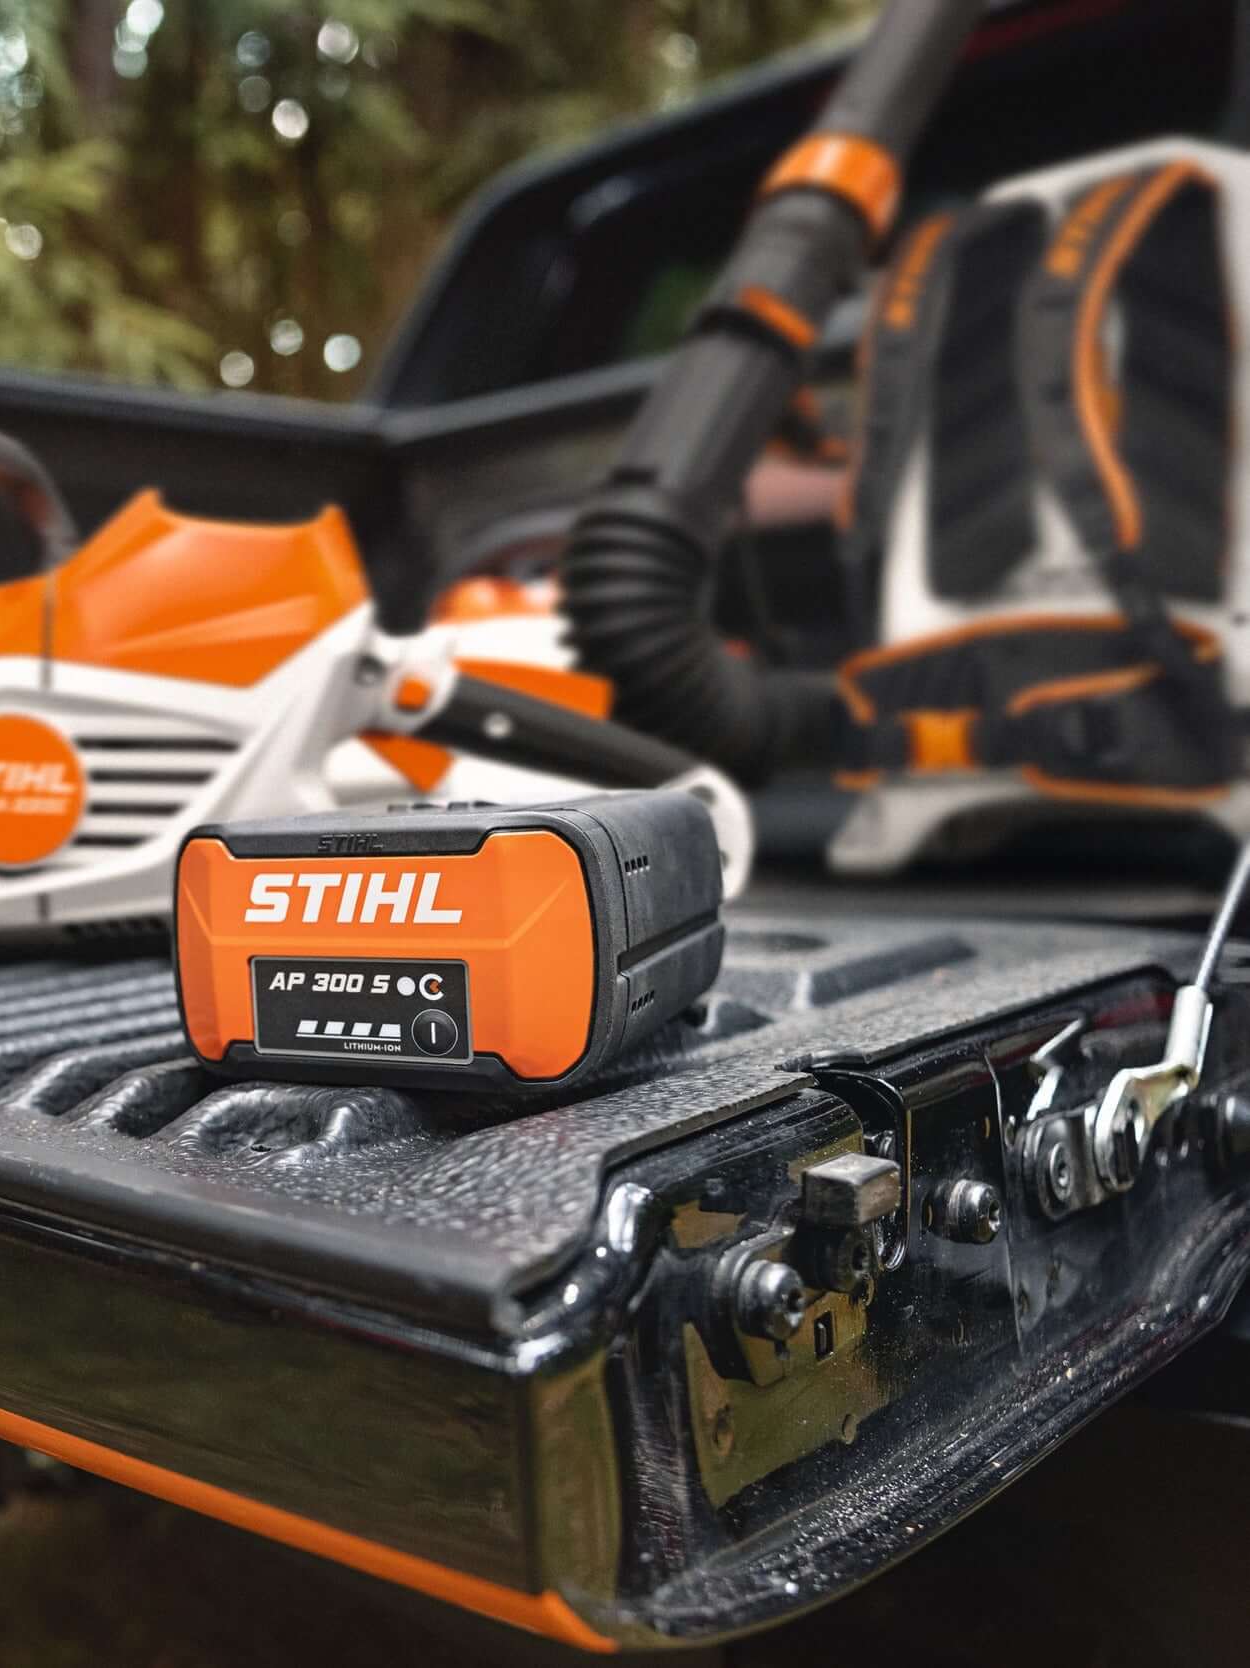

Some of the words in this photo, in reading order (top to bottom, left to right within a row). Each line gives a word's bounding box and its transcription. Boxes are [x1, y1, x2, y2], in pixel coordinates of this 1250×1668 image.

[318, 833, 383, 852] STIHL
[244, 872, 463, 924] STIHL
[269, 972, 305, 991] AP
[312, 973, 364, 993] 300
[370, 974, 391, 994] S
[344, 1042, 401, 1052] LITHIUM-ION
